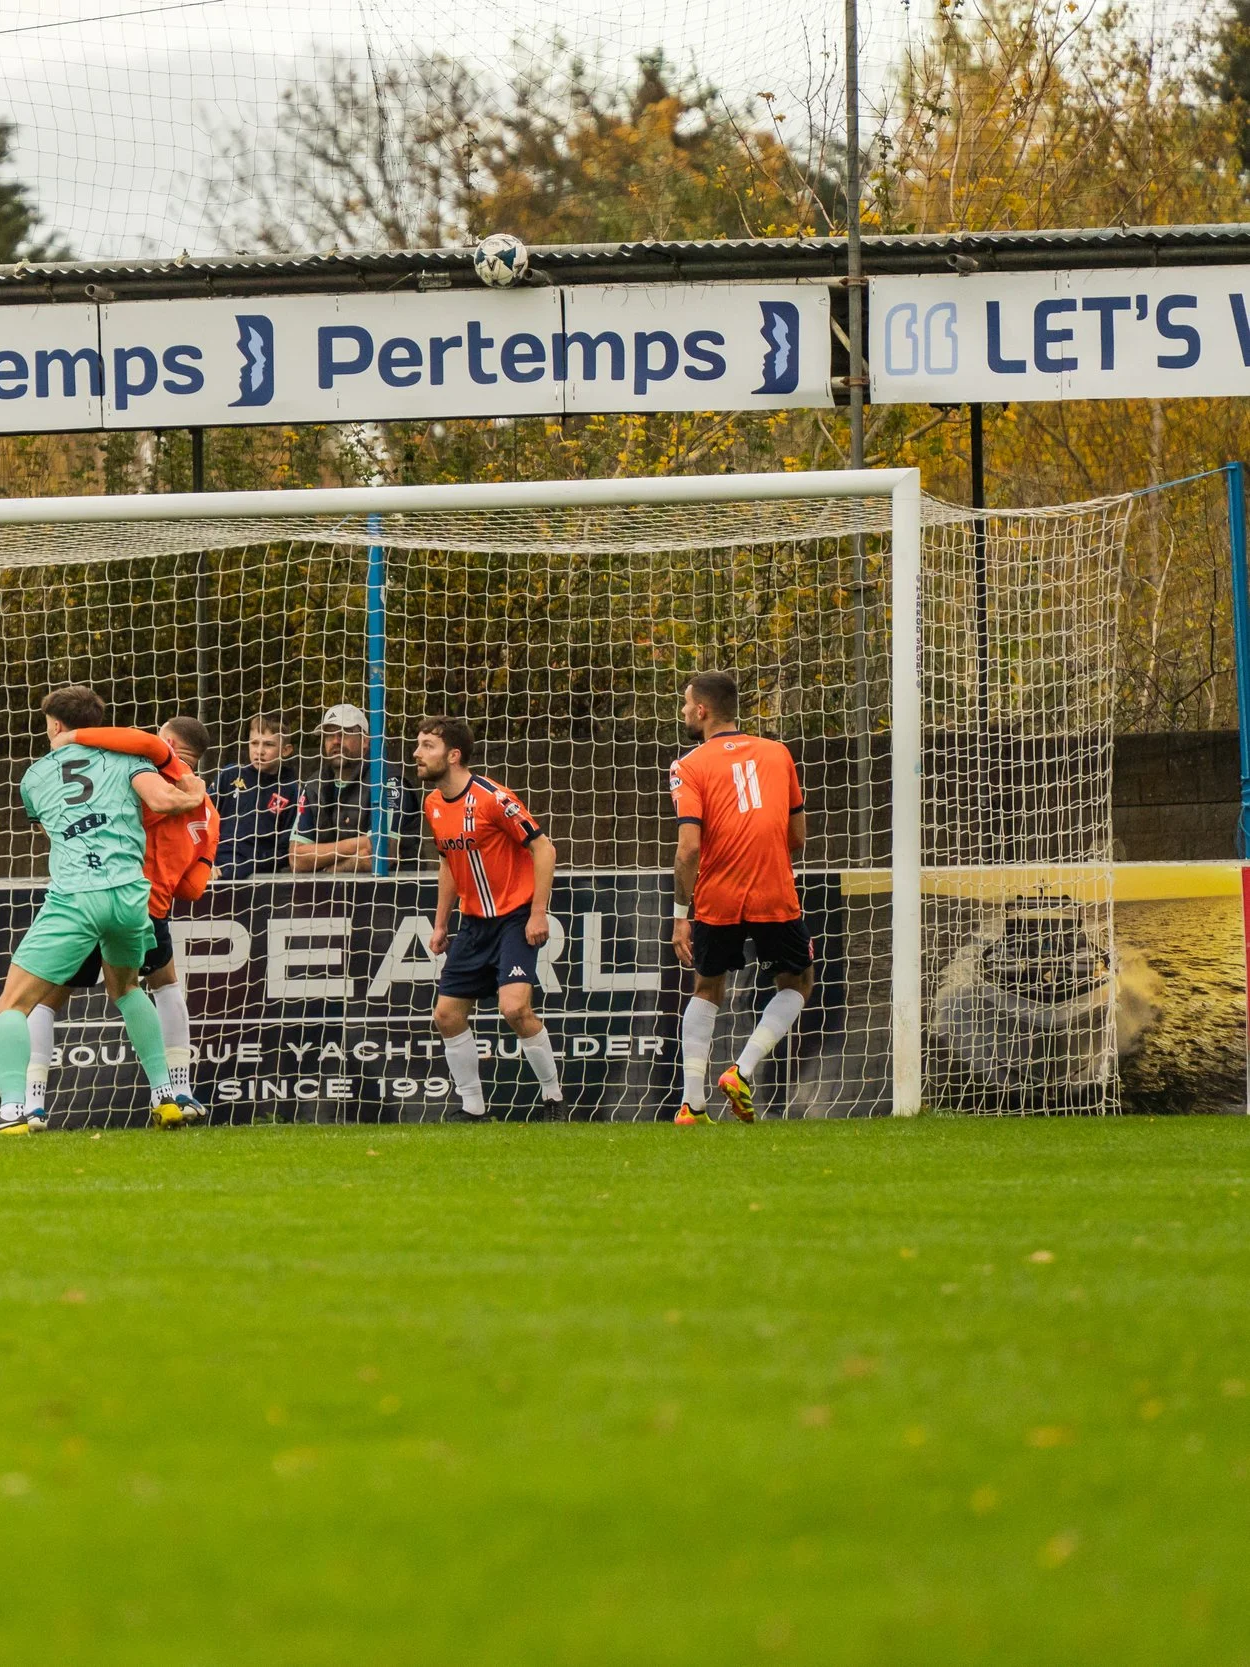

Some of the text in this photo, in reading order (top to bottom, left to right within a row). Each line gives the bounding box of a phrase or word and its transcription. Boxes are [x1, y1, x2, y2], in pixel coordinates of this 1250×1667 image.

[317, 320, 726, 396] Pertemps
[986, 294, 1200, 374] LET'S
[61, 759, 94, 806] 5
[731, 759, 763, 813] 11
[286, 1040, 441, 1062] YACHT
[218, 1078, 354, 1100] SINCE
